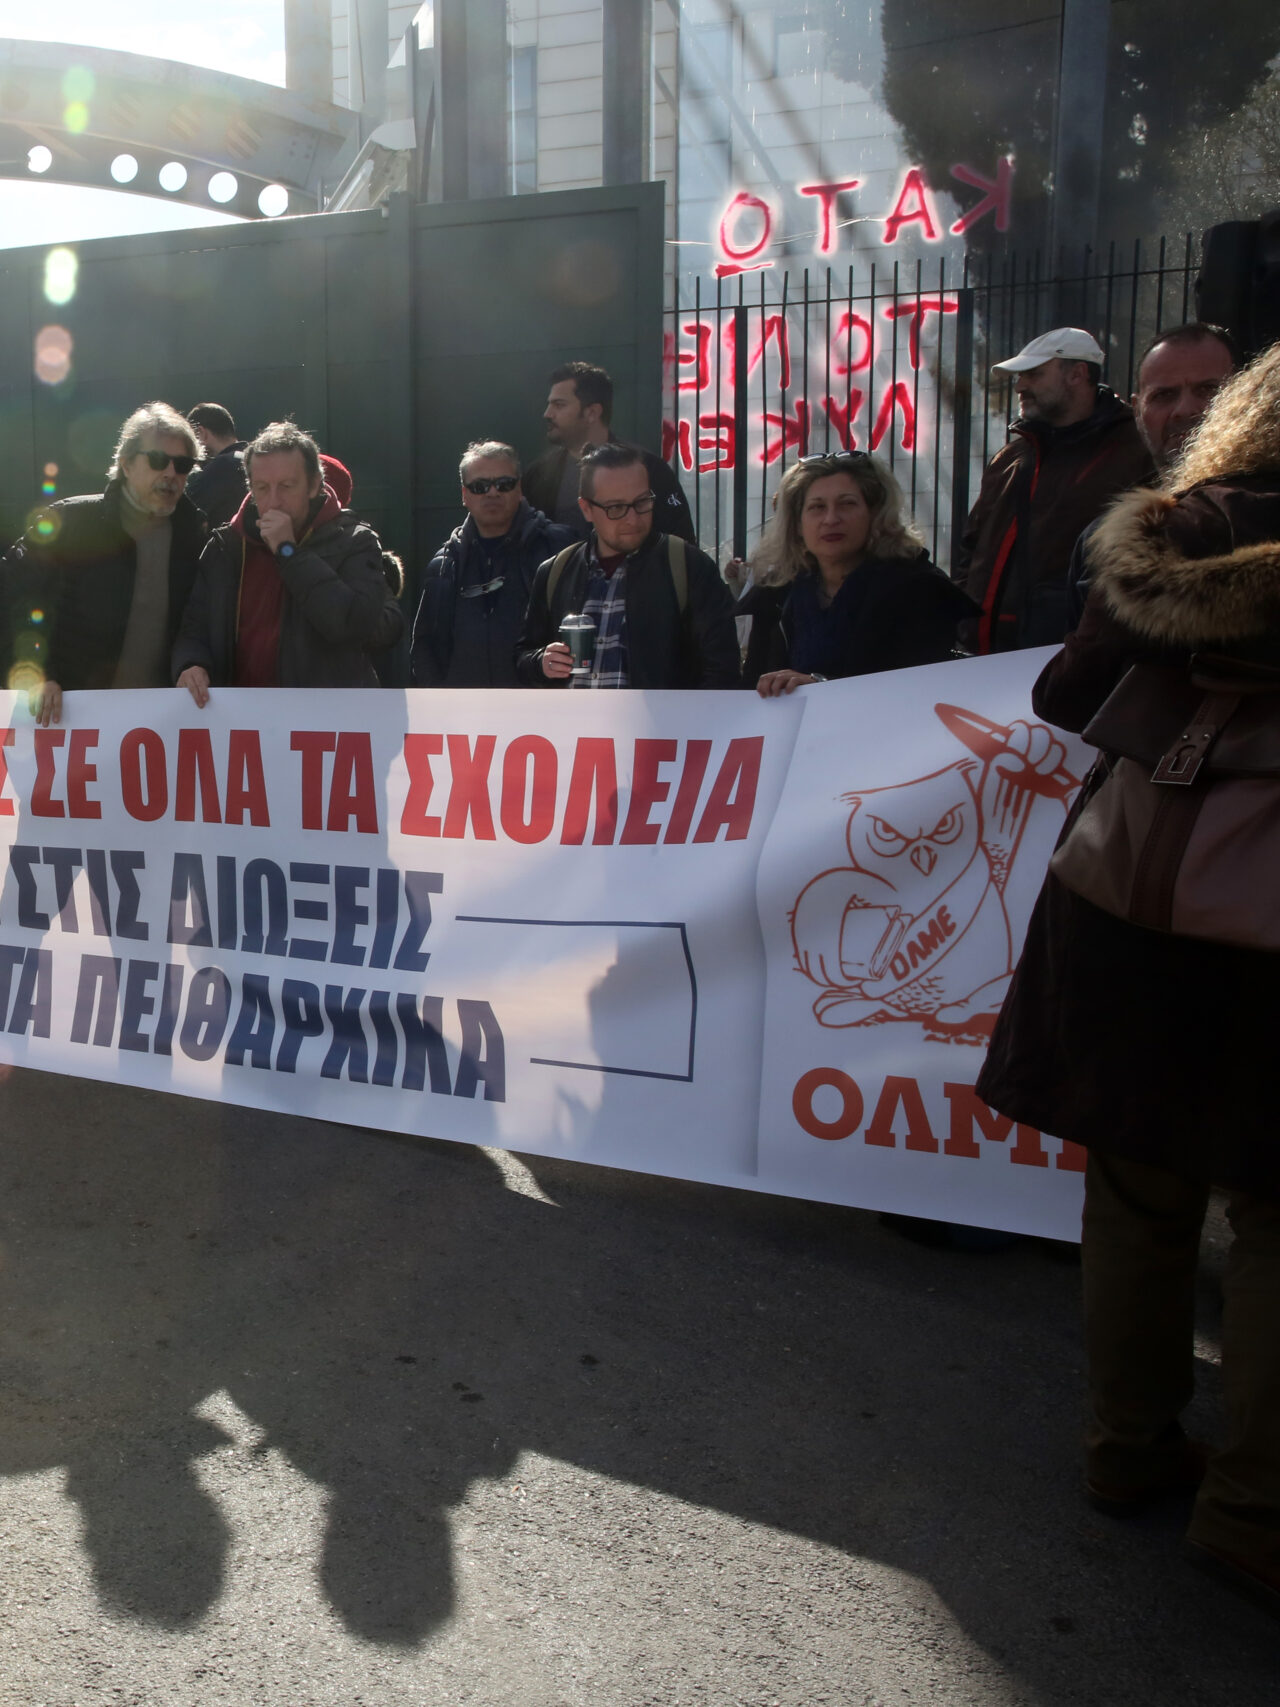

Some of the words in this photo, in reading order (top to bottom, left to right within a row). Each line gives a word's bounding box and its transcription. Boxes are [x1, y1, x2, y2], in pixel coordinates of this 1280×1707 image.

[31, 729, 102, 819] ΣΕ
[120, 727, 270, 828] ΟΛΑ
[290, 731, 379, 834] ΤΑ
[400, 734, 764, 846] ΣΧΟΛΕΙΑ
[9, 844, 150, 941] ΣΤΙΣ
[167, 852, 444, 972] ΔΙΩΞΕΙΣ
[889, 904, 957, 981] ΟΛΜΕ
[70, 953, 506, 1103] ΠΕΙΘΑΡΧΙΚΑ
[792, 1067, 1087, 1173] ΟΛΜ
